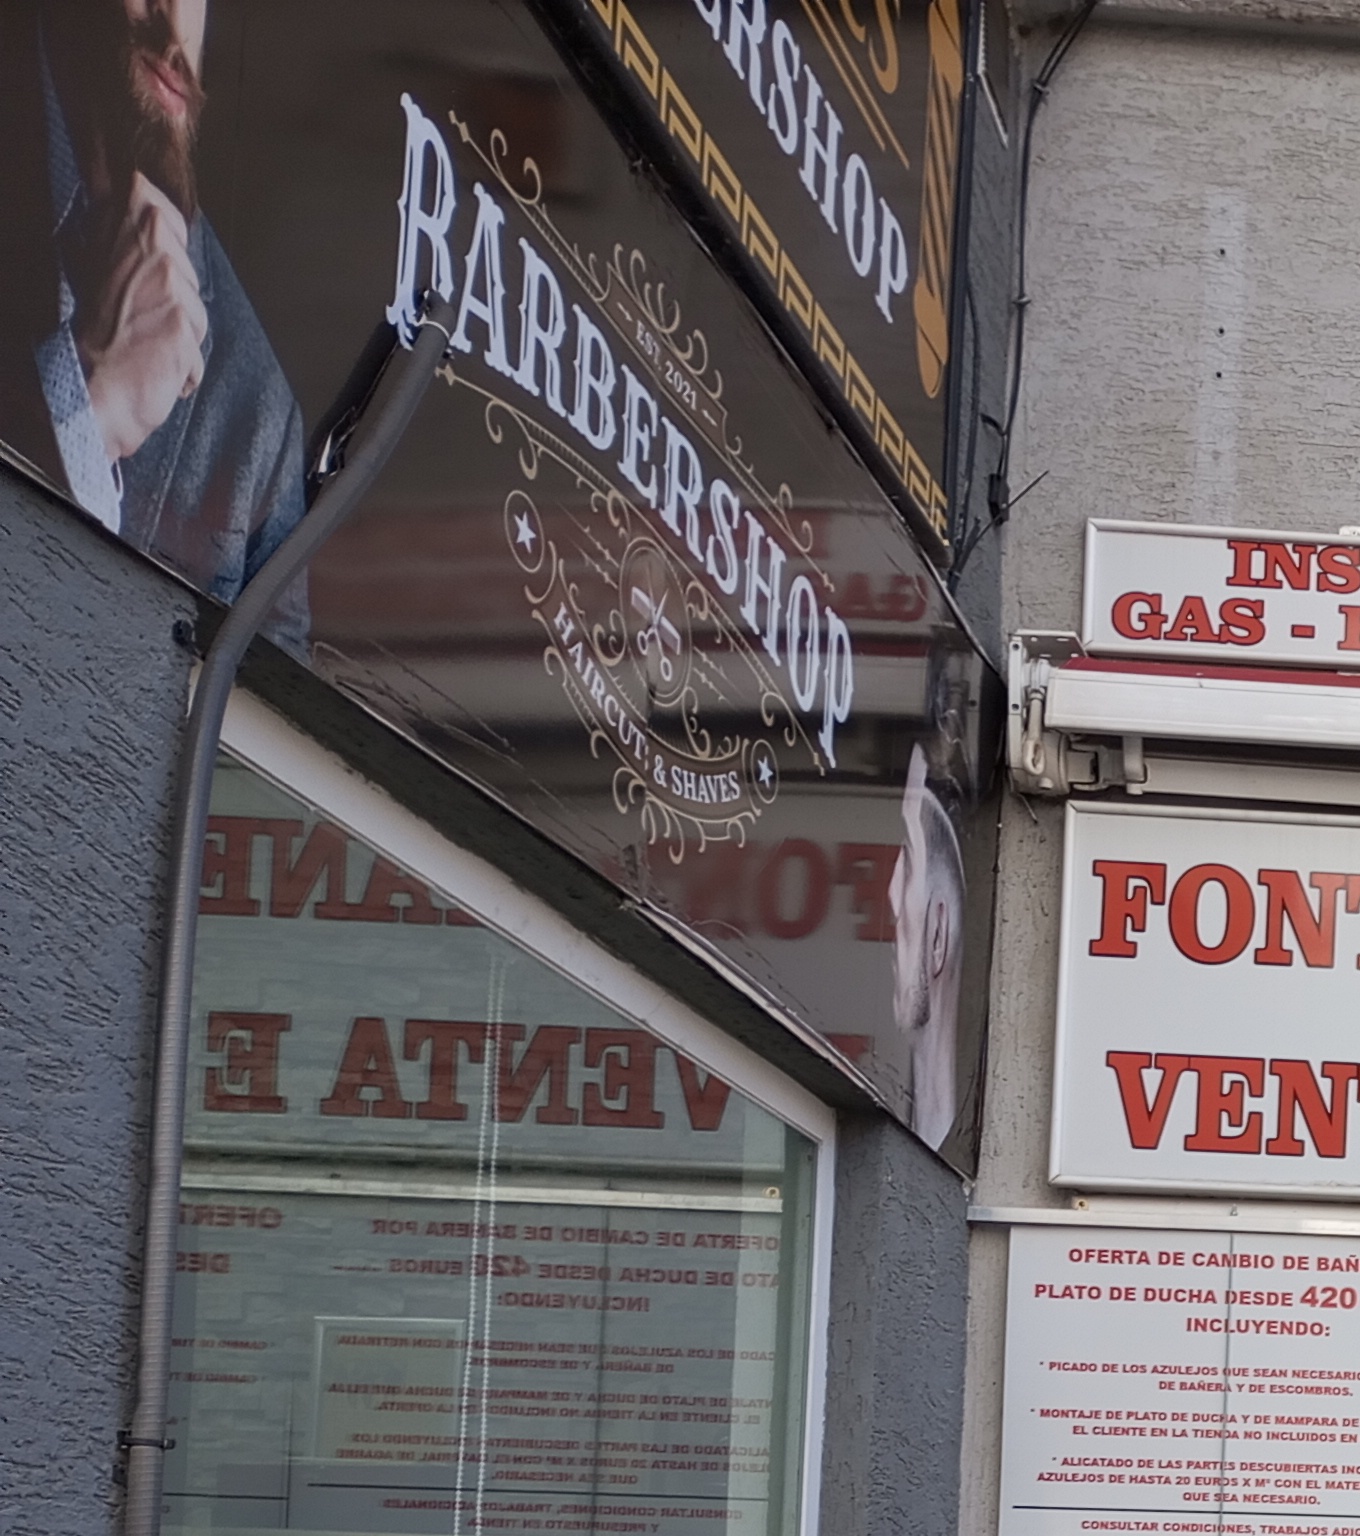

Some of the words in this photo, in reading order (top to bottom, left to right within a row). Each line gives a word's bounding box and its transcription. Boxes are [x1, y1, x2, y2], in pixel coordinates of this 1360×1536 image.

[386, 93, 854, 767] BARBERSHOP
[1112, 592, 1266, 643] GAS
[671, 765, 740, 803] SHAVES
[1067, 1247, 1152, 1265] OFERTA
[1155, 1250, 1185, 1267] DE
[1190, 1251, 1277, 1270] CAMBIO
[1281, 1254, 1310, 1272] DE
[1033, 1283, 1104, 1301] PLATO
[1107, 1285, 1137, 1303] DE
[1142, 1286, 1219, 1305] DUCHA
[1225, 1289, 1294, 1308] DESDE
[1298, 1285, 1359, 1310] 420
[1185, 1317, 1329, 1337] INCLUYENDO:
